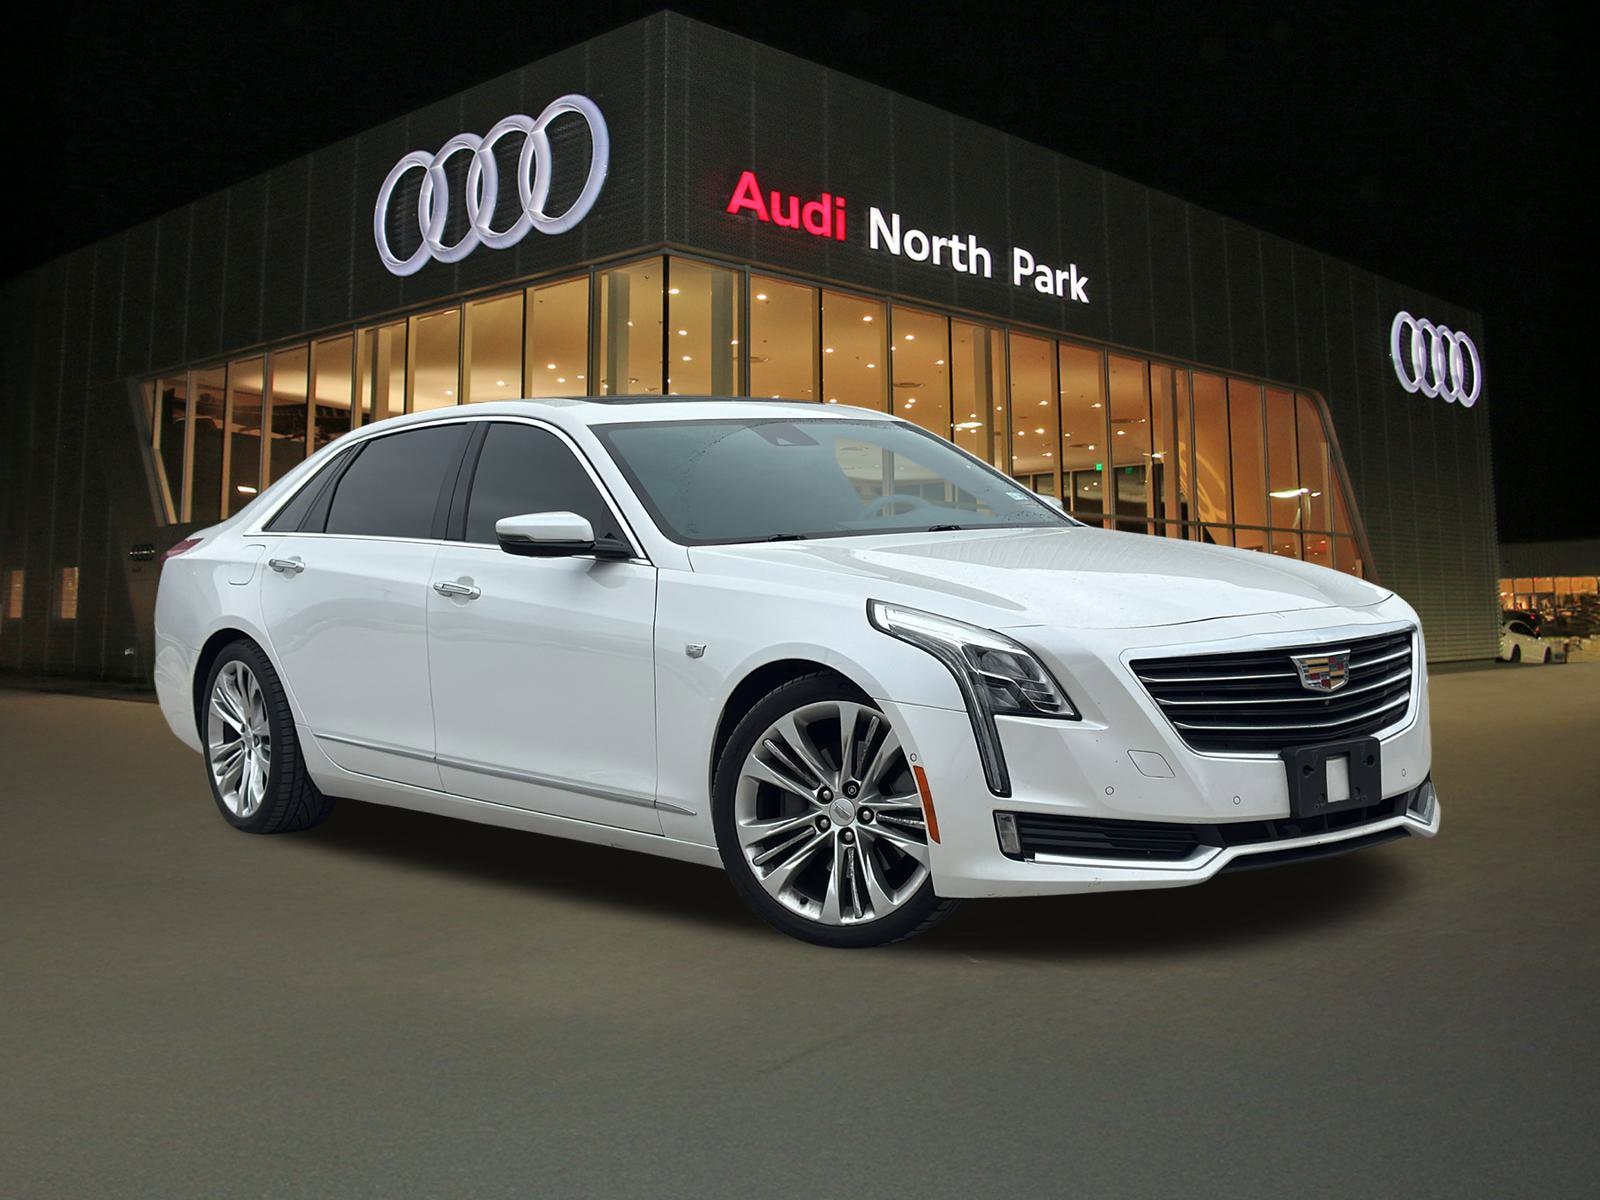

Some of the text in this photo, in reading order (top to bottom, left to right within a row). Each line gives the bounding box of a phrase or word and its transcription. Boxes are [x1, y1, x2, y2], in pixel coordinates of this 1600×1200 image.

[727, 171, 1090, 304] Audi North Park
